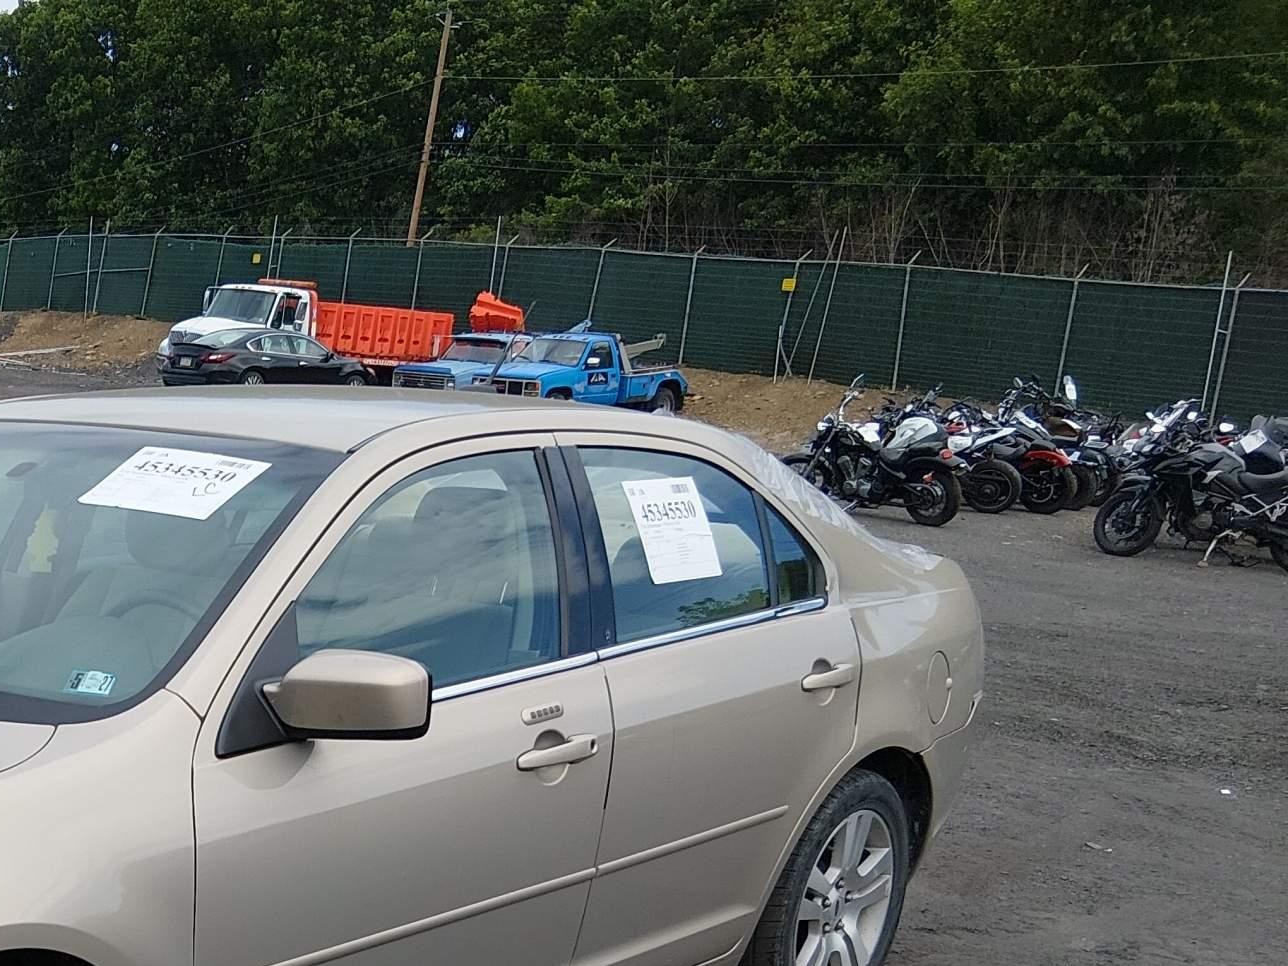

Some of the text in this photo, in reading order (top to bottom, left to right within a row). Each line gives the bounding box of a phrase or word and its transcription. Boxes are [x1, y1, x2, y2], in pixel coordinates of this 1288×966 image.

[134, 460, 237, 482] 45345530
[641, 500, 697, 521] 45345530
[98, 675, 114, 691] 27
